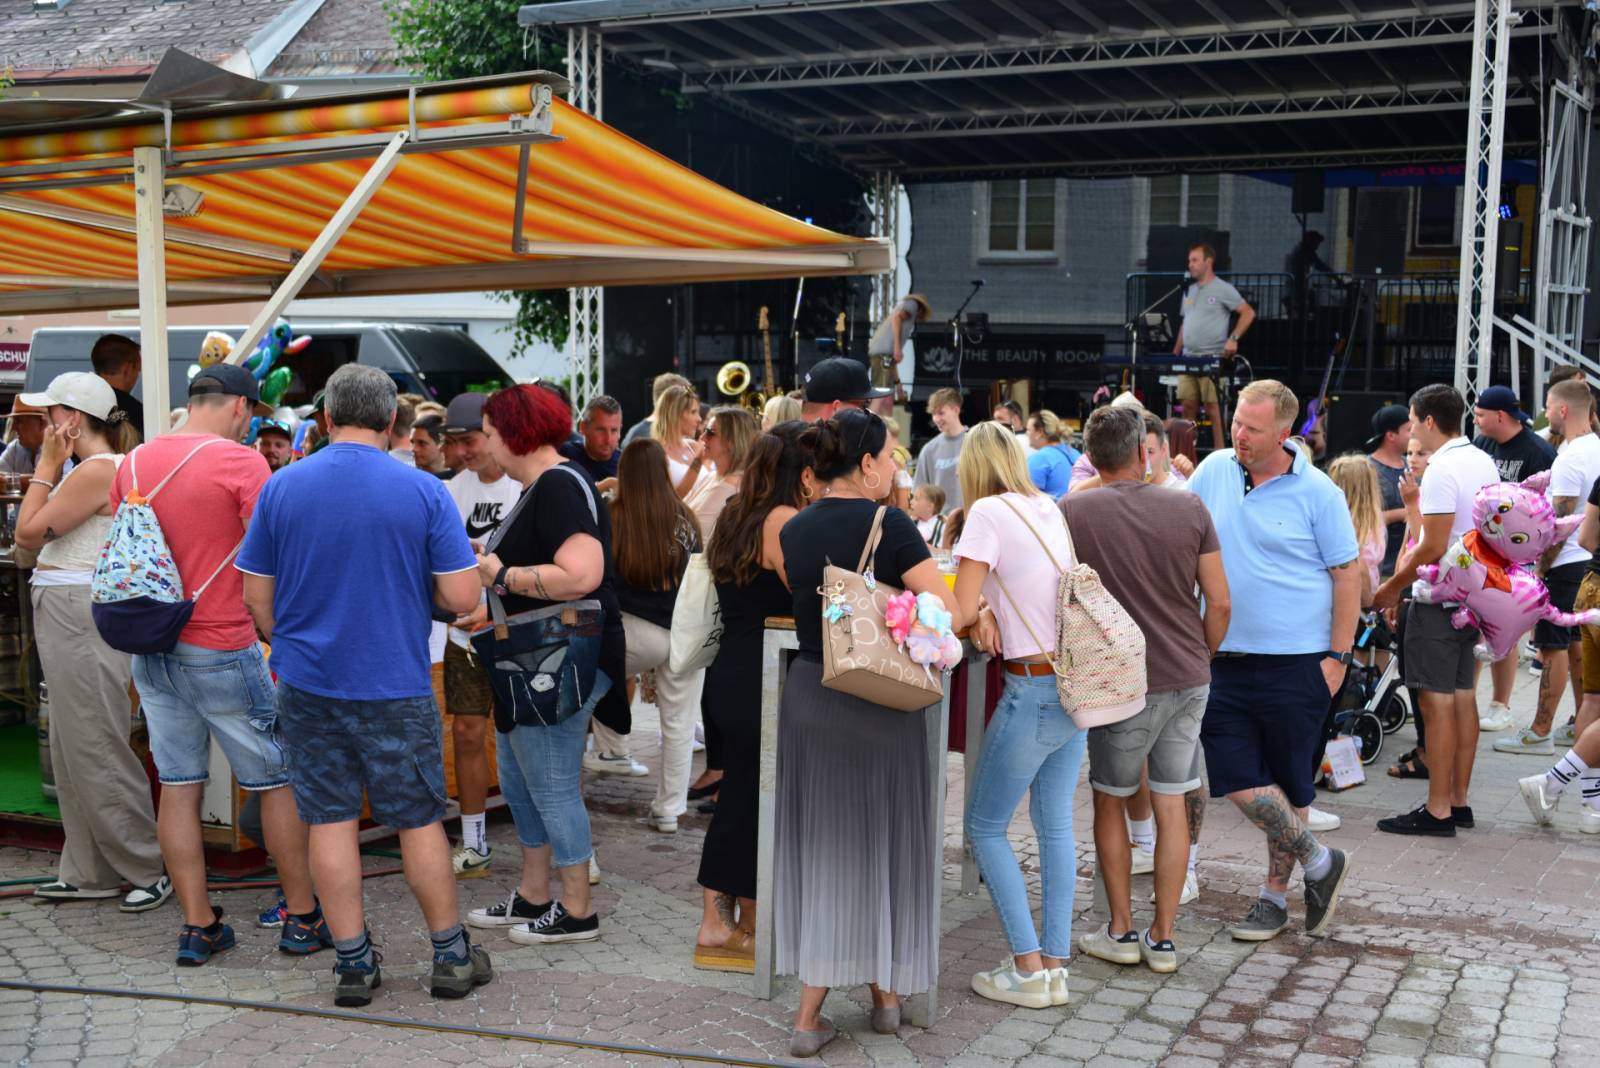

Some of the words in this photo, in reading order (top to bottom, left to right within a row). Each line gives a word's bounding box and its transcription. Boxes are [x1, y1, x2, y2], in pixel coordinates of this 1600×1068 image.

[964, 349, 989, 362] THE
[996, 349, 1047, 363] BEAUTY
[1056, 350, 1101, 363] ROOM
[472, 502, 503, 523] NIKE
